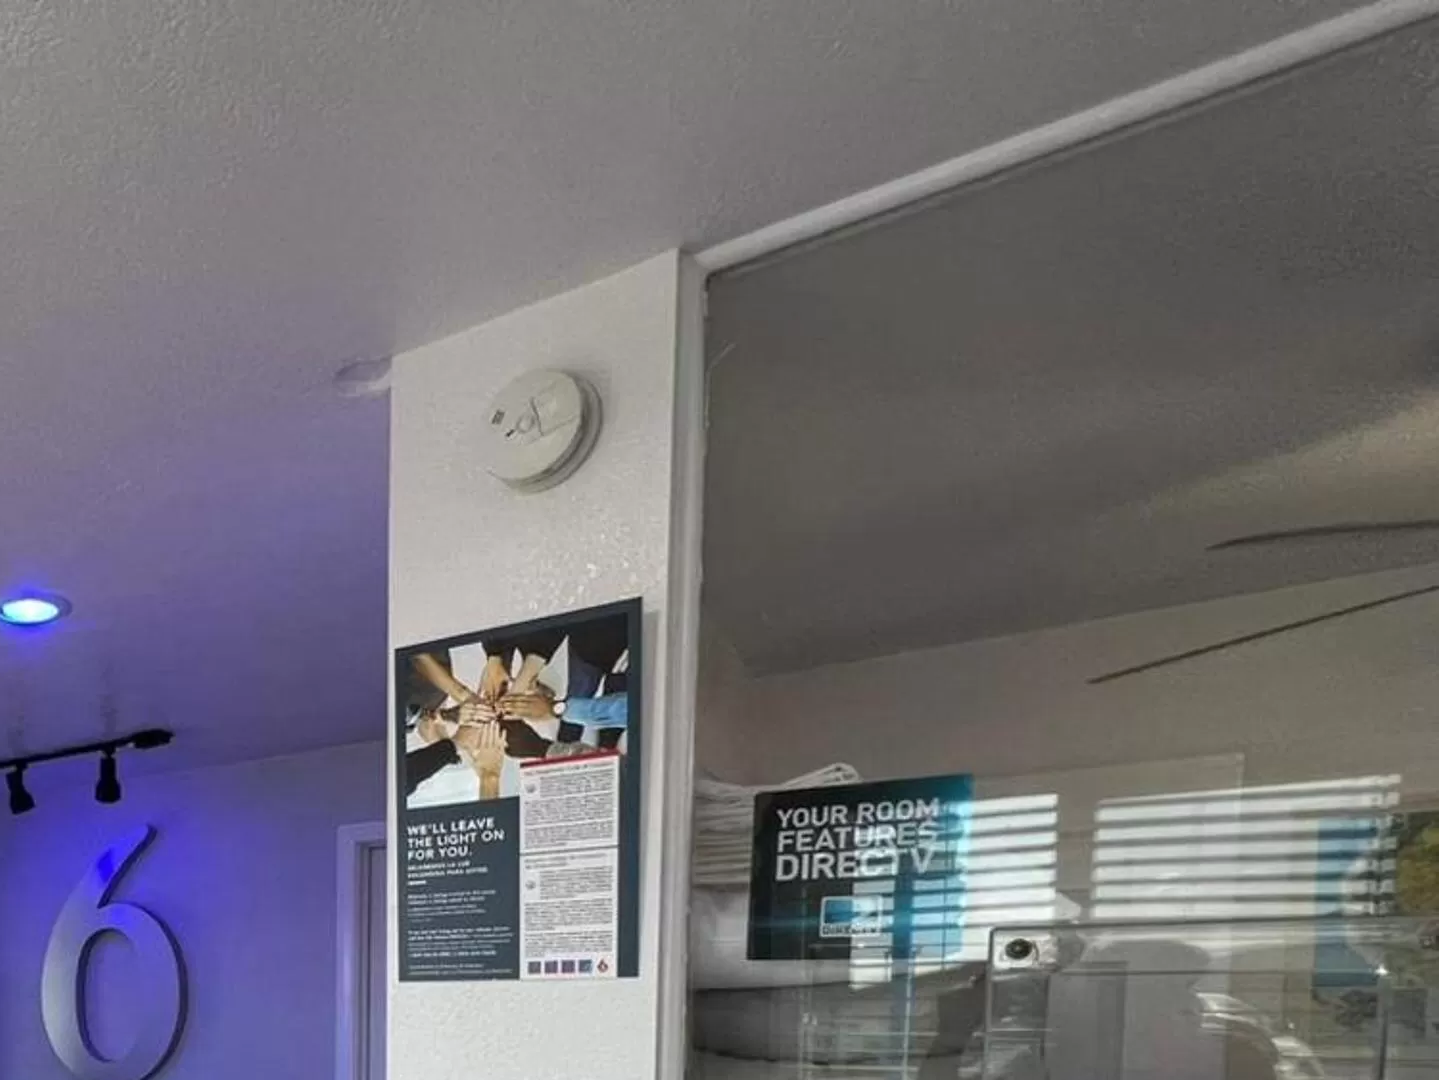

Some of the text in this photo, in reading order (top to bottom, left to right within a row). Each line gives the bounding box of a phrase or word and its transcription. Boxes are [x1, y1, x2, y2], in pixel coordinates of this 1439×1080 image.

[776, 798, 940, 828] YOUR ROOM
[407, 817, 495, 836] WE'LL LEAVE
[408, 828, 505, 848] THE LIGHT ON
[776, 820, 938, 852] FEATURES
[407, 845, 473, 860] FOR YOU.
[775, 847, 933, 881] DIRECTV
